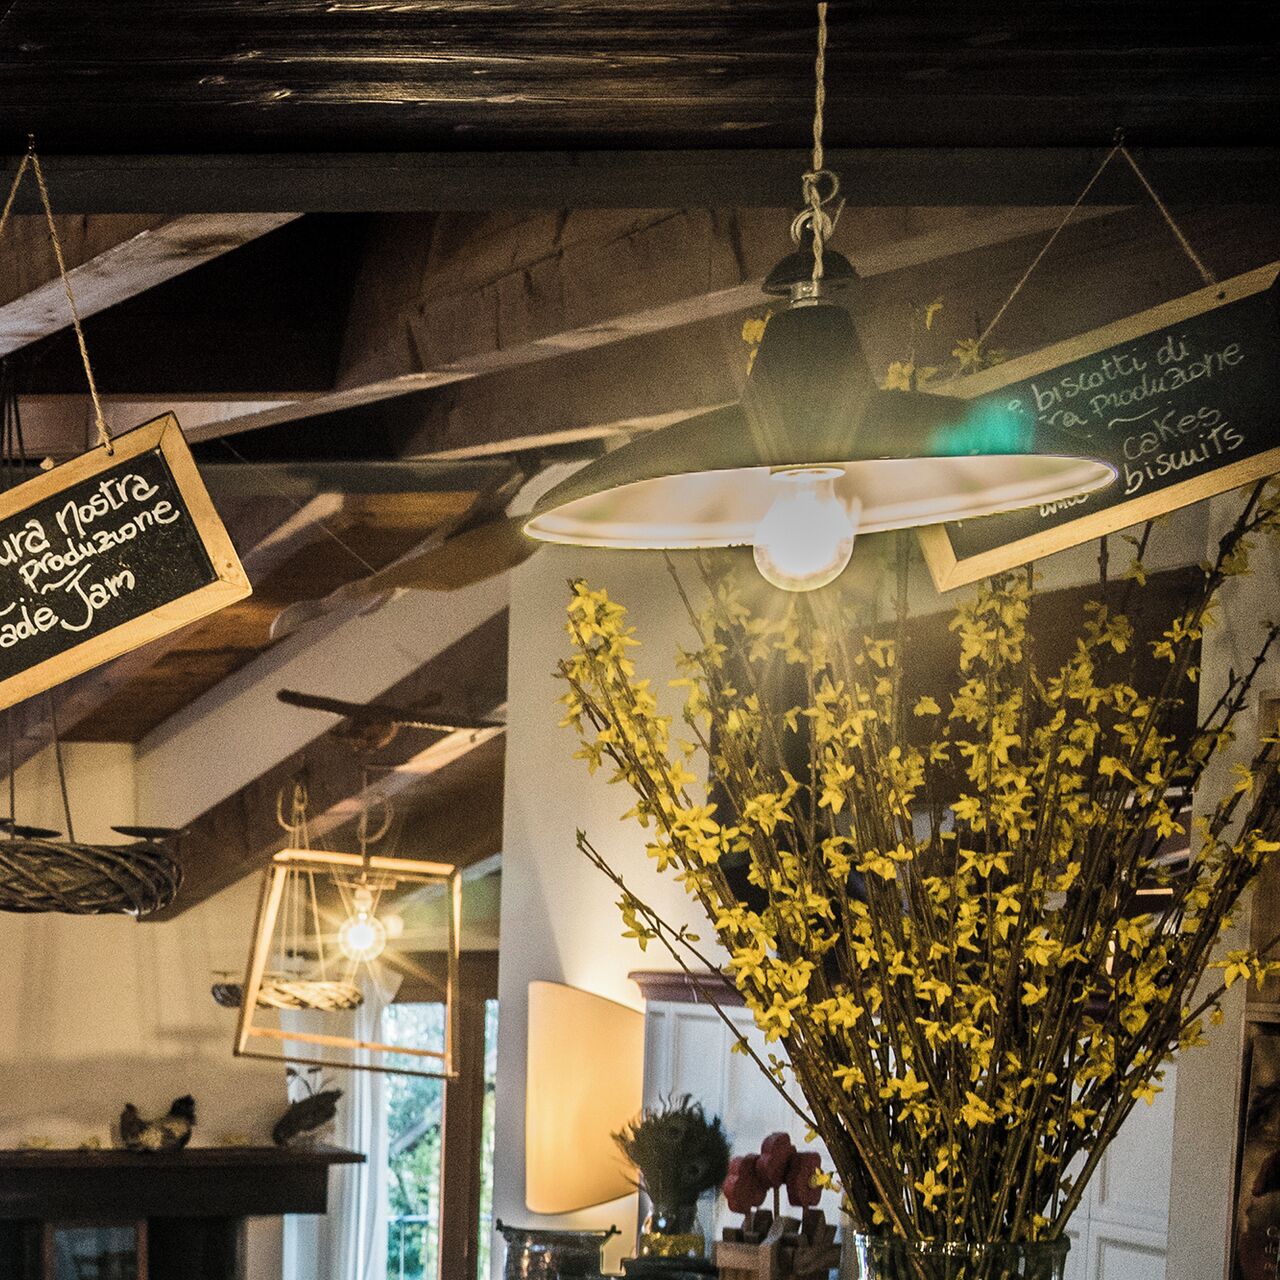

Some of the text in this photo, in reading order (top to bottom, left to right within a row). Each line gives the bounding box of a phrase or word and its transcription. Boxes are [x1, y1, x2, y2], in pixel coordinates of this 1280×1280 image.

[1031, 334, 1190, 412] biscotti di
[18, 499, 181, 593] produzione
[59, 563, 135, 633] Jam
